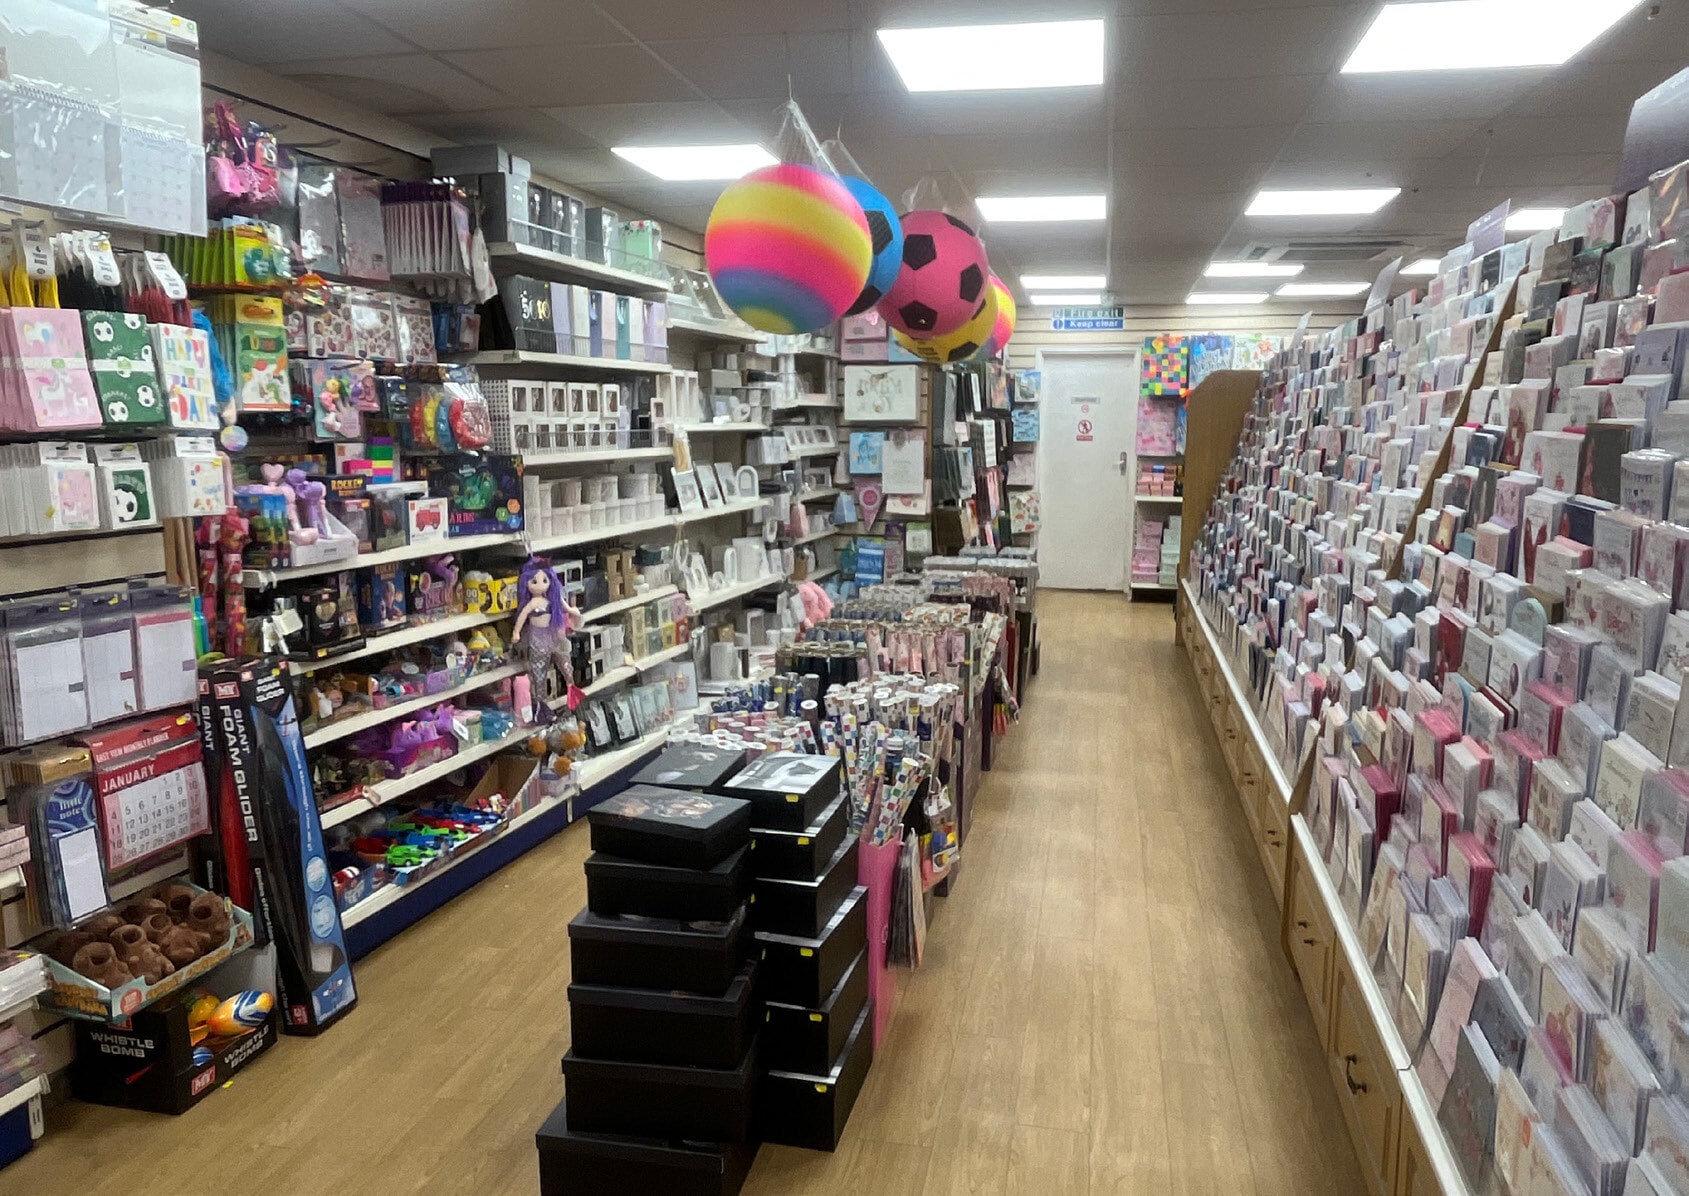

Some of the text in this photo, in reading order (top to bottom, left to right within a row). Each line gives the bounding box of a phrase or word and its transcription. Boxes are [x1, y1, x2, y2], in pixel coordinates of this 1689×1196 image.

[1070, 308, 1119, 318] Fire exit
[165, 338, 205, 368] HAPPY
[201, 705, 214, 750] GIANT
[233, 708, 250, 754] GIANT
[102, 763, 156, 793] JANUARY
[219, 705, 258, 842] FOAM GLIDER
[125, 806, 131, 815] 5
[138, 801, 144, 810] 6
[152, 796, 157, 804] 7
[165, 791, 171, 800] 8
[177, 786, 183, 795] 9
[125, 820, 135, 830] 12
[138, 814, 149, 824] 13
[152, 809, 162, 819] 14
[165, 805, 175, 814] 15
[126, 834, 136, 844] 19
[139, 828, 149, 839] 20
[152, 824, 162, 833] 21
[165, 818, 176, 828] 22
[178, 813, 188, 822] 23
[90, 1031, 154, 1049] WHISTLE
[101, 1044, 145, 1058] BOMB
[224, 1024, 269, 1064] WHISTLE
[230, 1039, 264, 1069] BOMB
